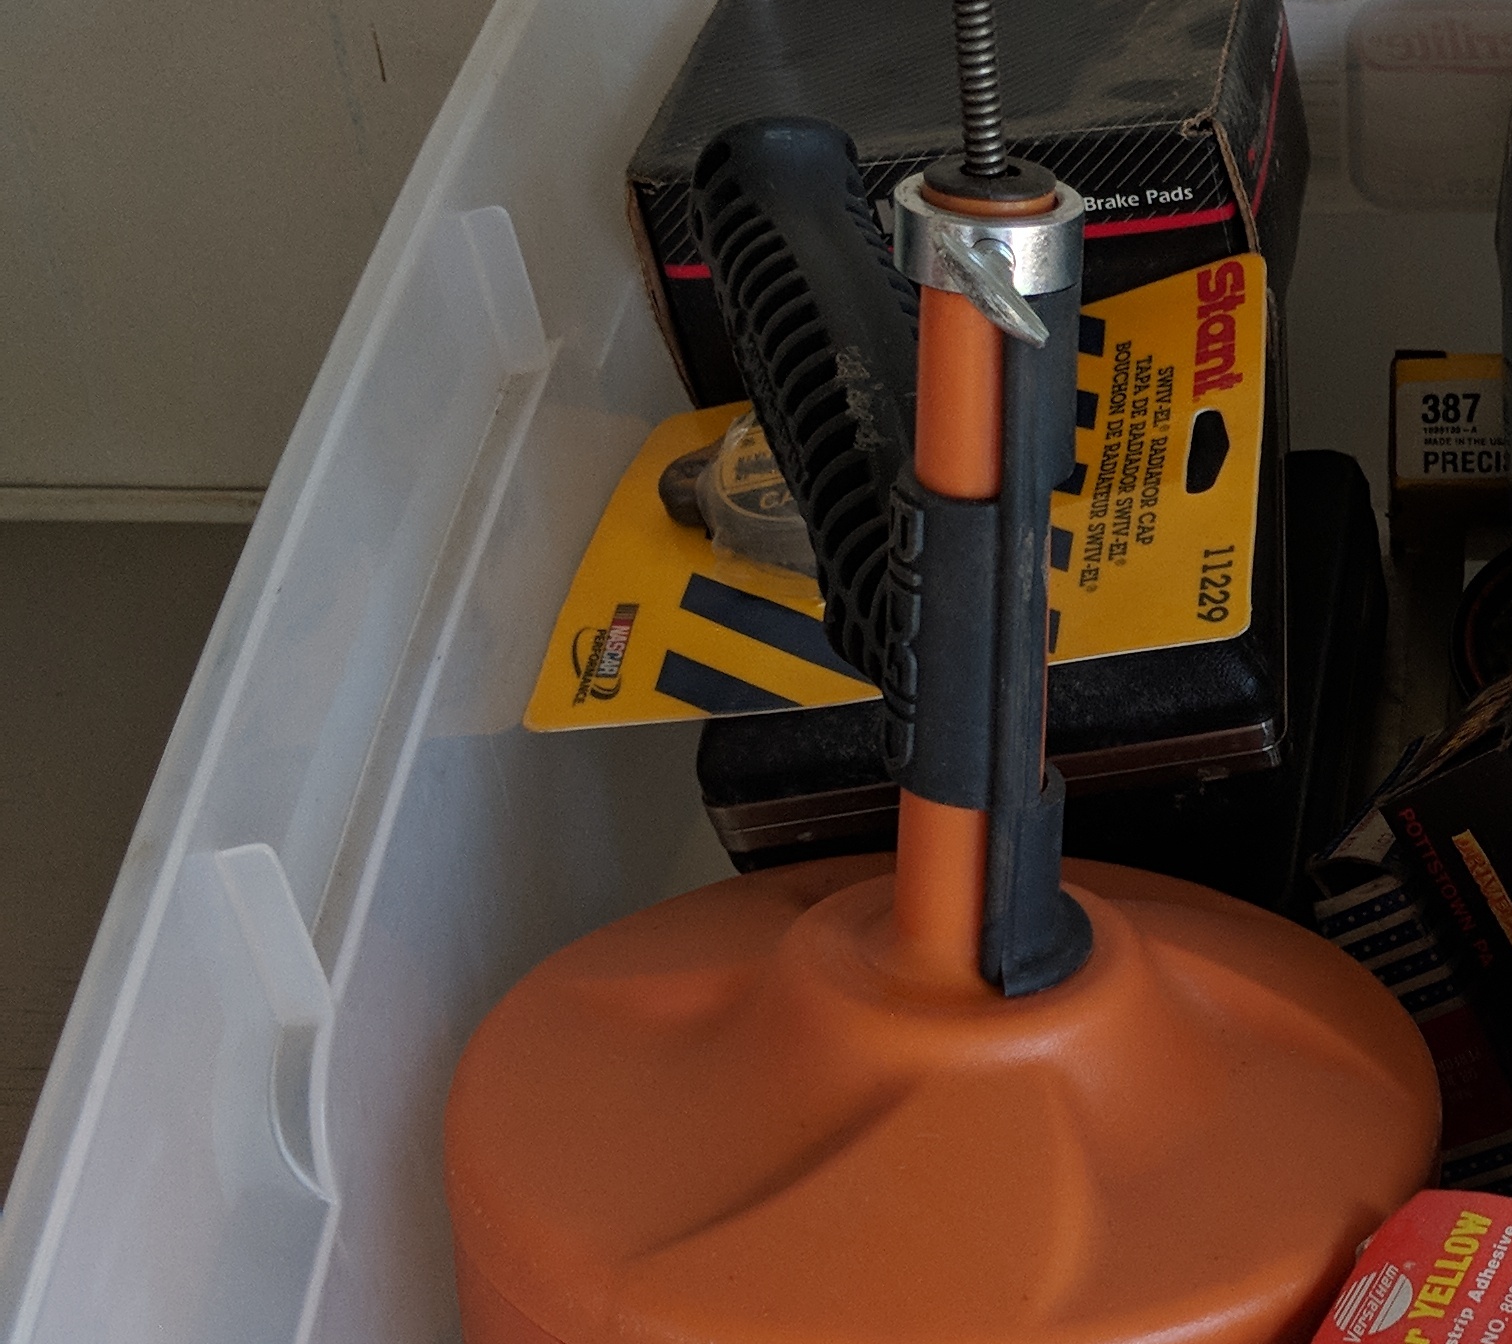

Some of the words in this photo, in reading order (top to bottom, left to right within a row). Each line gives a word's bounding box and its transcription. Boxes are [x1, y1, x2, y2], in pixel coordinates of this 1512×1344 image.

[1082, 192, 1141, 213] Brake
[1145, 185, 1194, 205] Pads
[1194, 260, 1246, 405] Stant
[1108, 339, 1132, 416] BOUCHON
[1133, 354, 1153, 396] TAPA
[1105, 417, 1124, 441] DE
[1130, 396, 1150, 419] DE
[1421, 392, 1481, 424] 387
[1118, 420, 1146, 495] RADIADOR
[1139, 435, 1169, 510] RADIATOR
[1424, 437, 1452, 446] MADE
[1467, 438, 1486, 446] THE
[1089, 441, 1121, 521] RADIATEUR
[1135, 511, 1157, 546] CAP
[1196, 543, 1235, 624] 11229
[573, 628, 607, 707] PERFORMANCE
[598, 624, 631, 676] NASCAR
[1406, 1210, 1493, 1319] YELLOW
